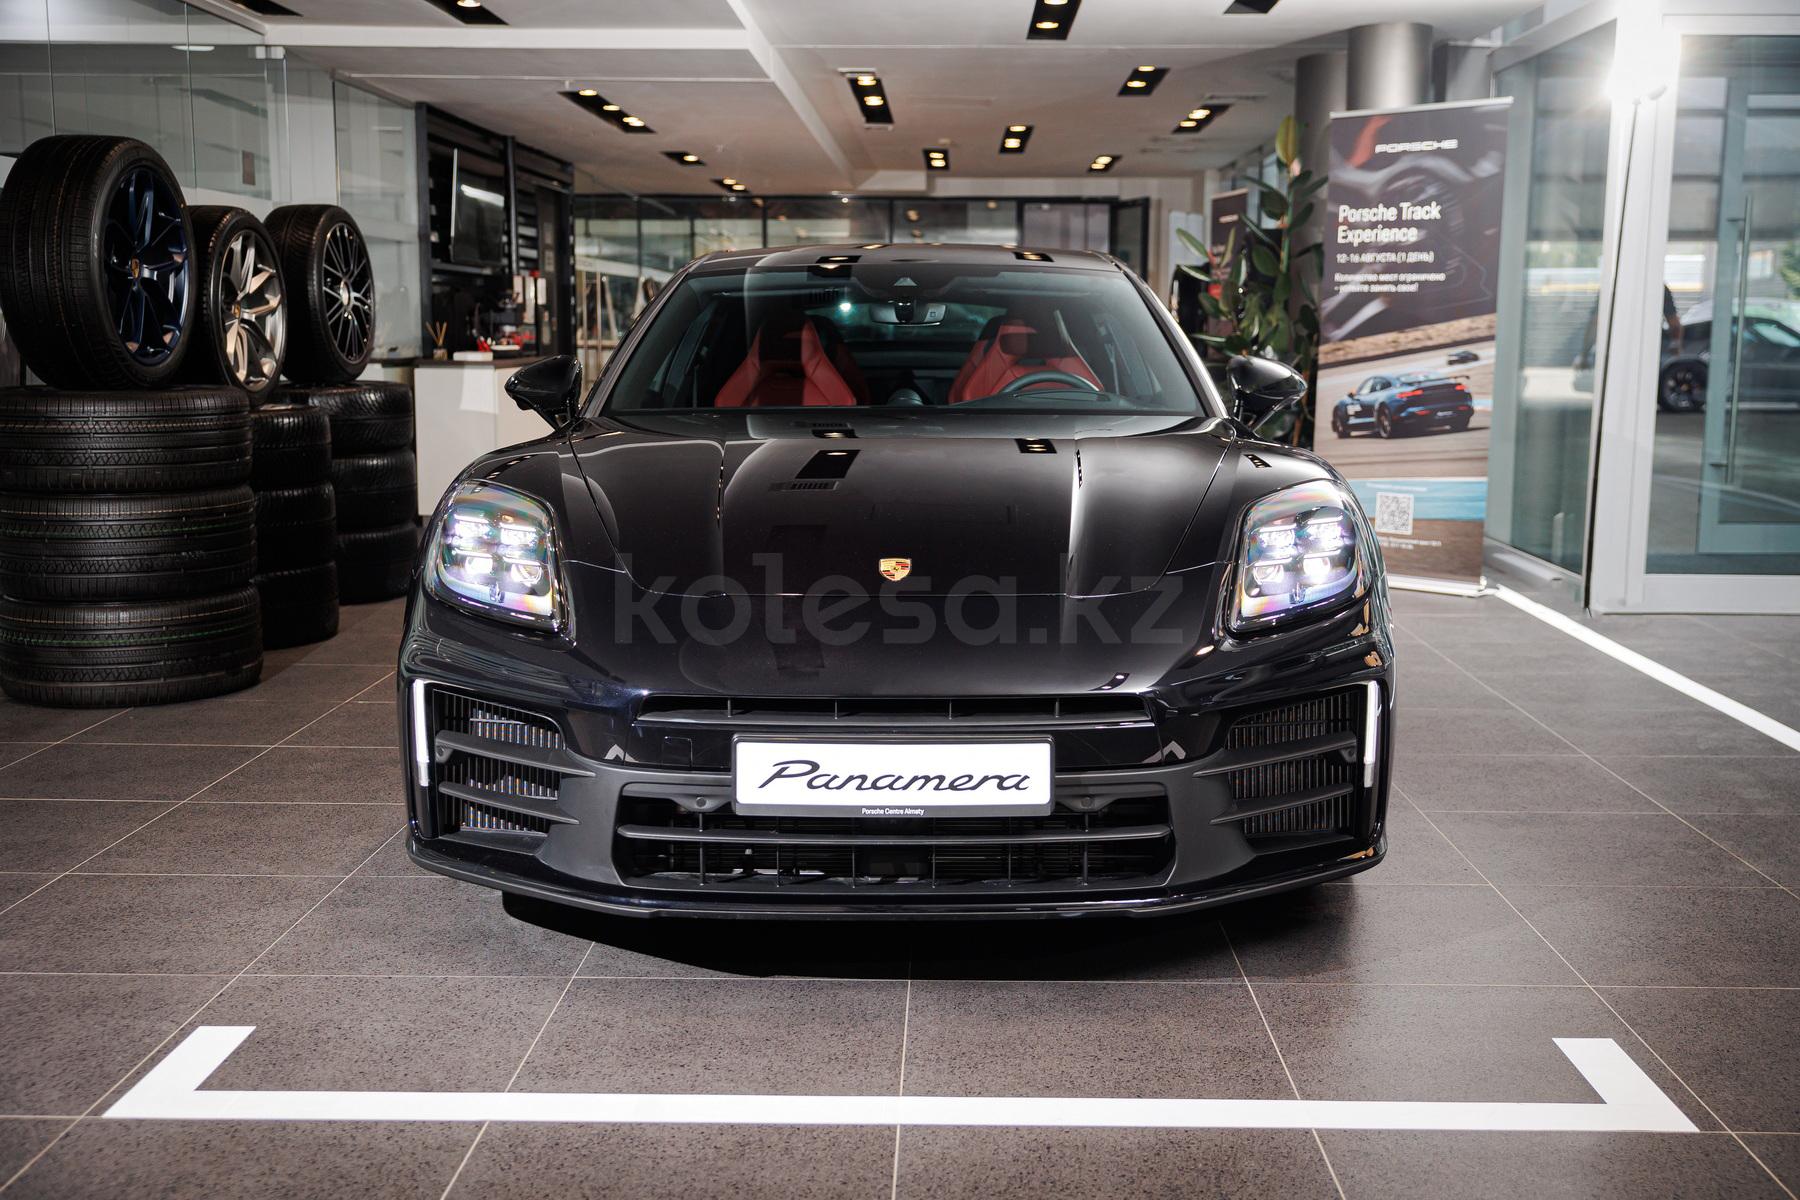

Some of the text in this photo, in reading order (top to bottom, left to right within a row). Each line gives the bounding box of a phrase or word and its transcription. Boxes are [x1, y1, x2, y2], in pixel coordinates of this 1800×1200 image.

[1375, 139, 1459, 153] PORSCHE
[1338, 201, 1442, 223] Porsche Track
[1337, 224, 1418, 247] Experience
[757, 759, 1031, 792] Panamera
[905, 808, 924, 816] Almaty
